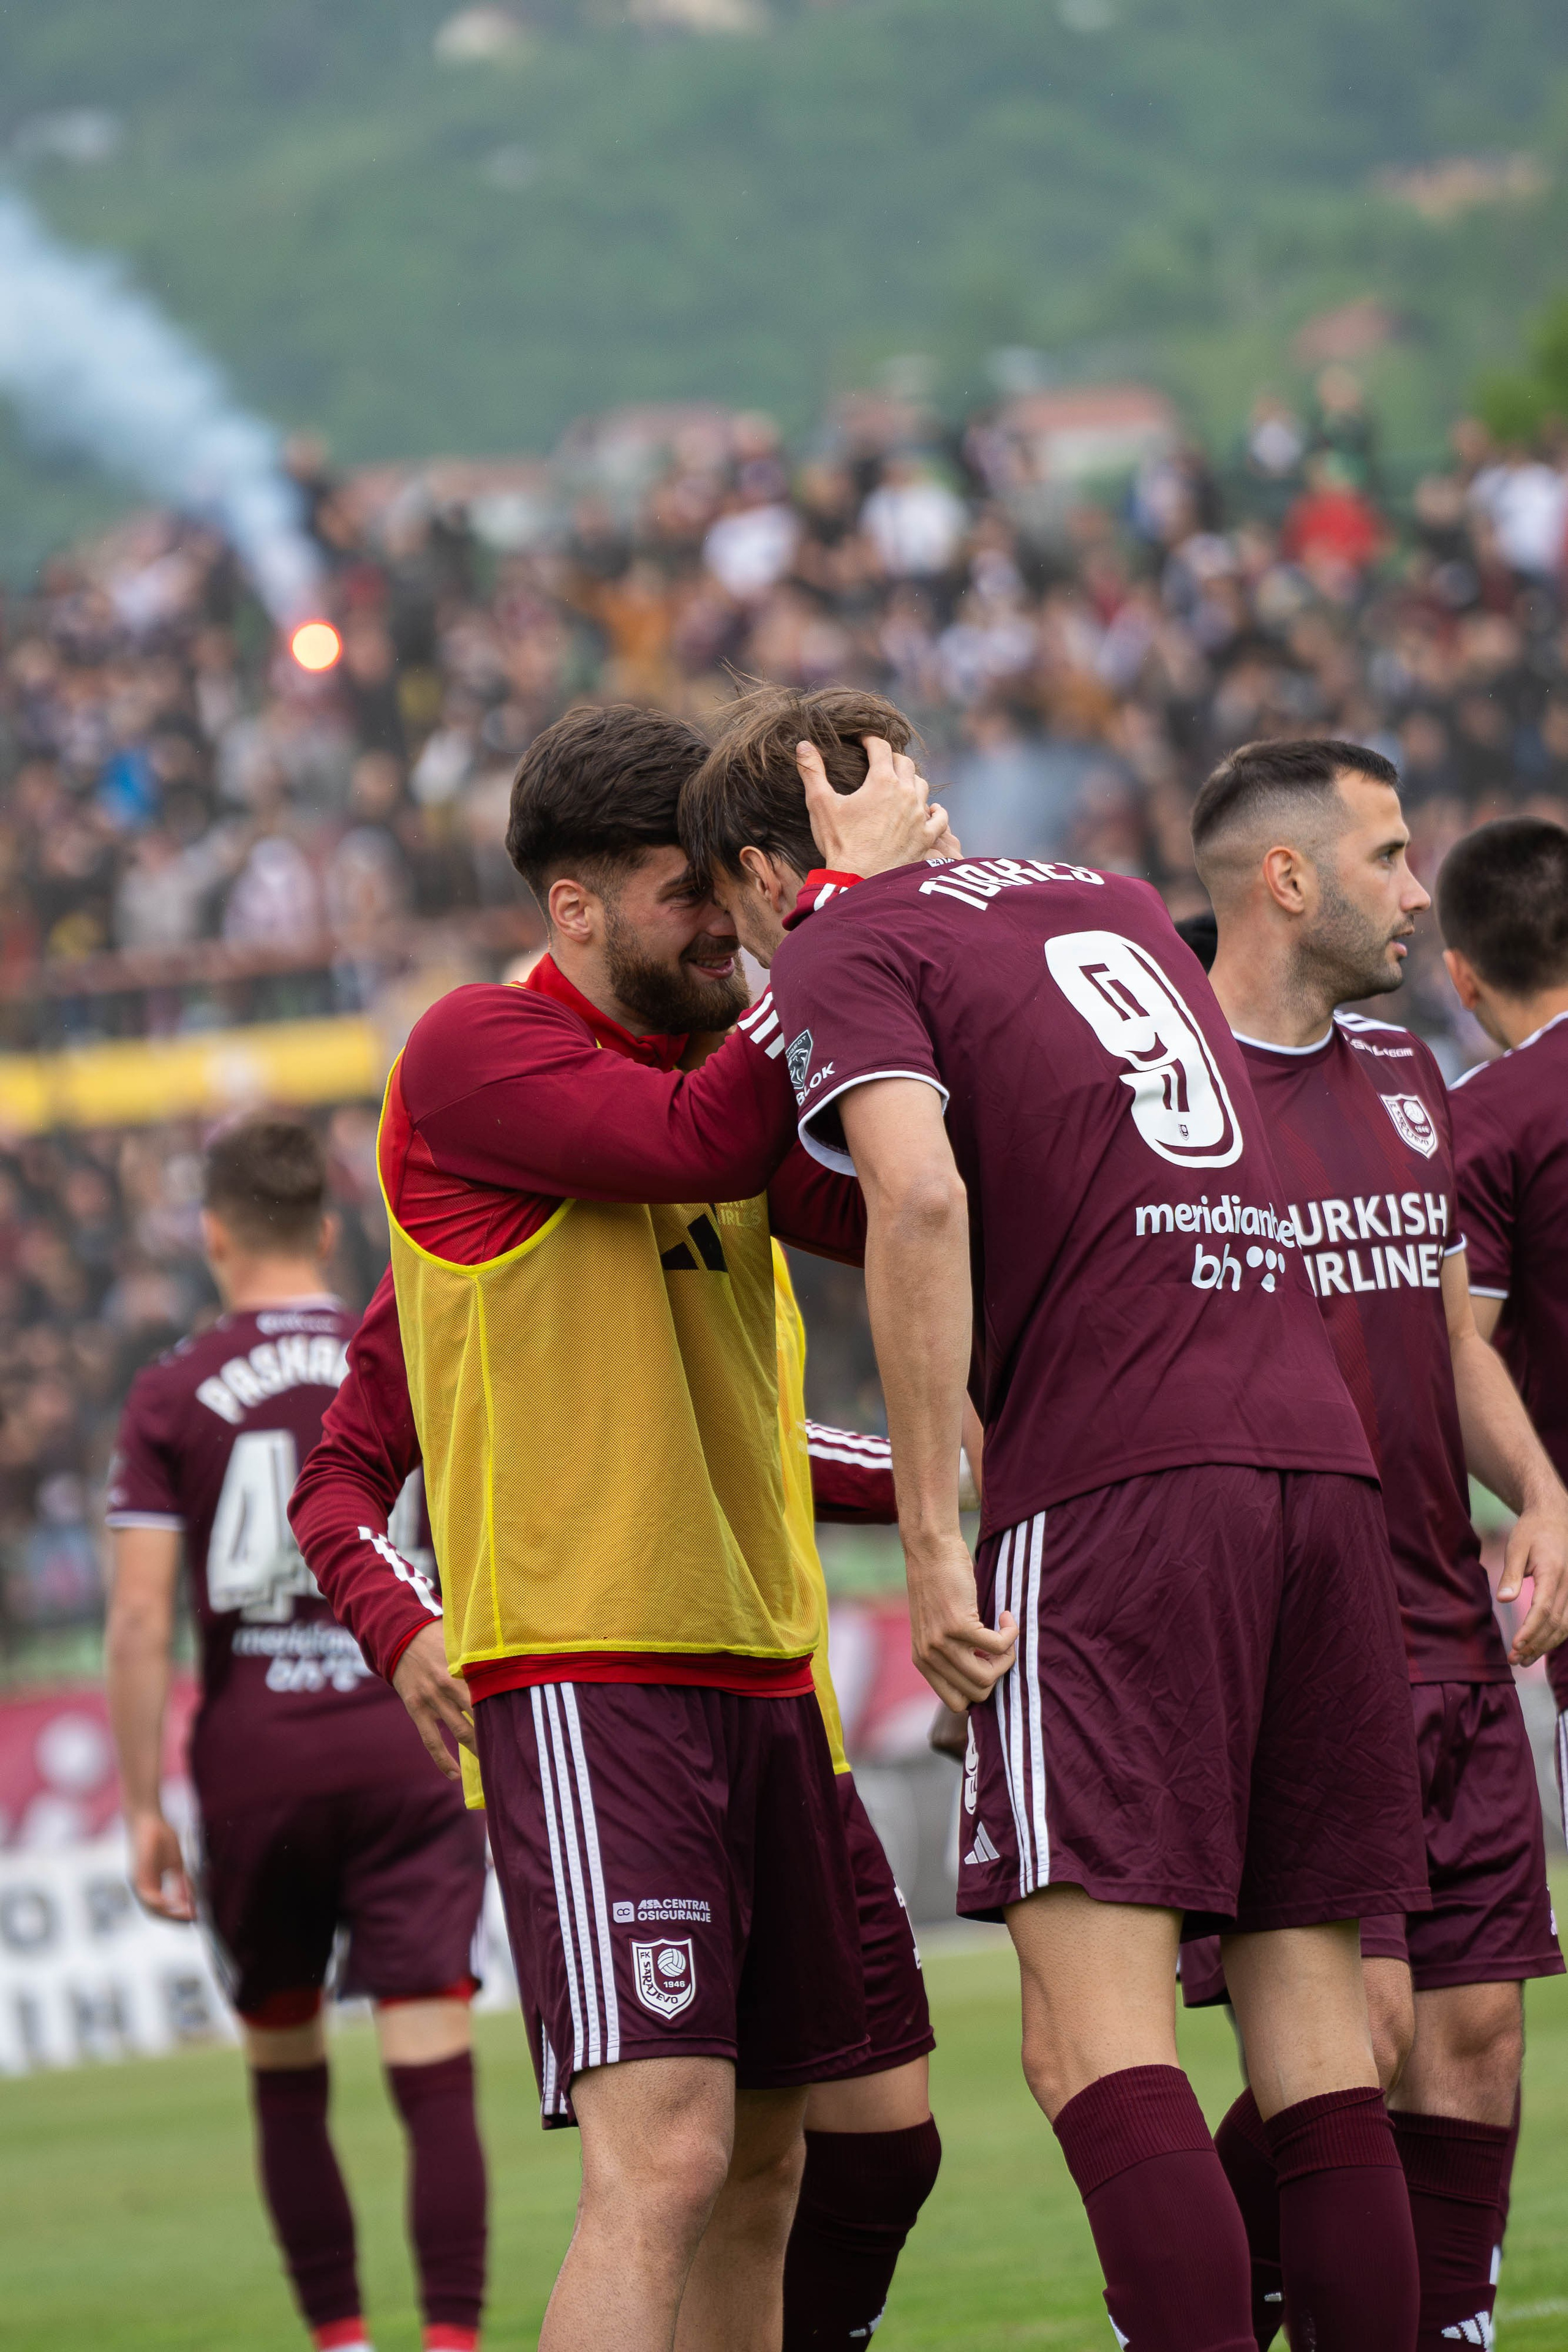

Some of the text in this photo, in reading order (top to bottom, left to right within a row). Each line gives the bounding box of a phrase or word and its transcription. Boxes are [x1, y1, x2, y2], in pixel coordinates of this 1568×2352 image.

[1044, 930, 1243, 1168] 9
[1135, 1195, 1302, 1250] meridianbe
[1287, 1193, 1447, 1246] URKISH
[1191, 1243, 1242, 1292] bh
[638, 1910, 712, 1923] OSIGURANJE
[642, 1961, 678, 2004] SARAJEVO
